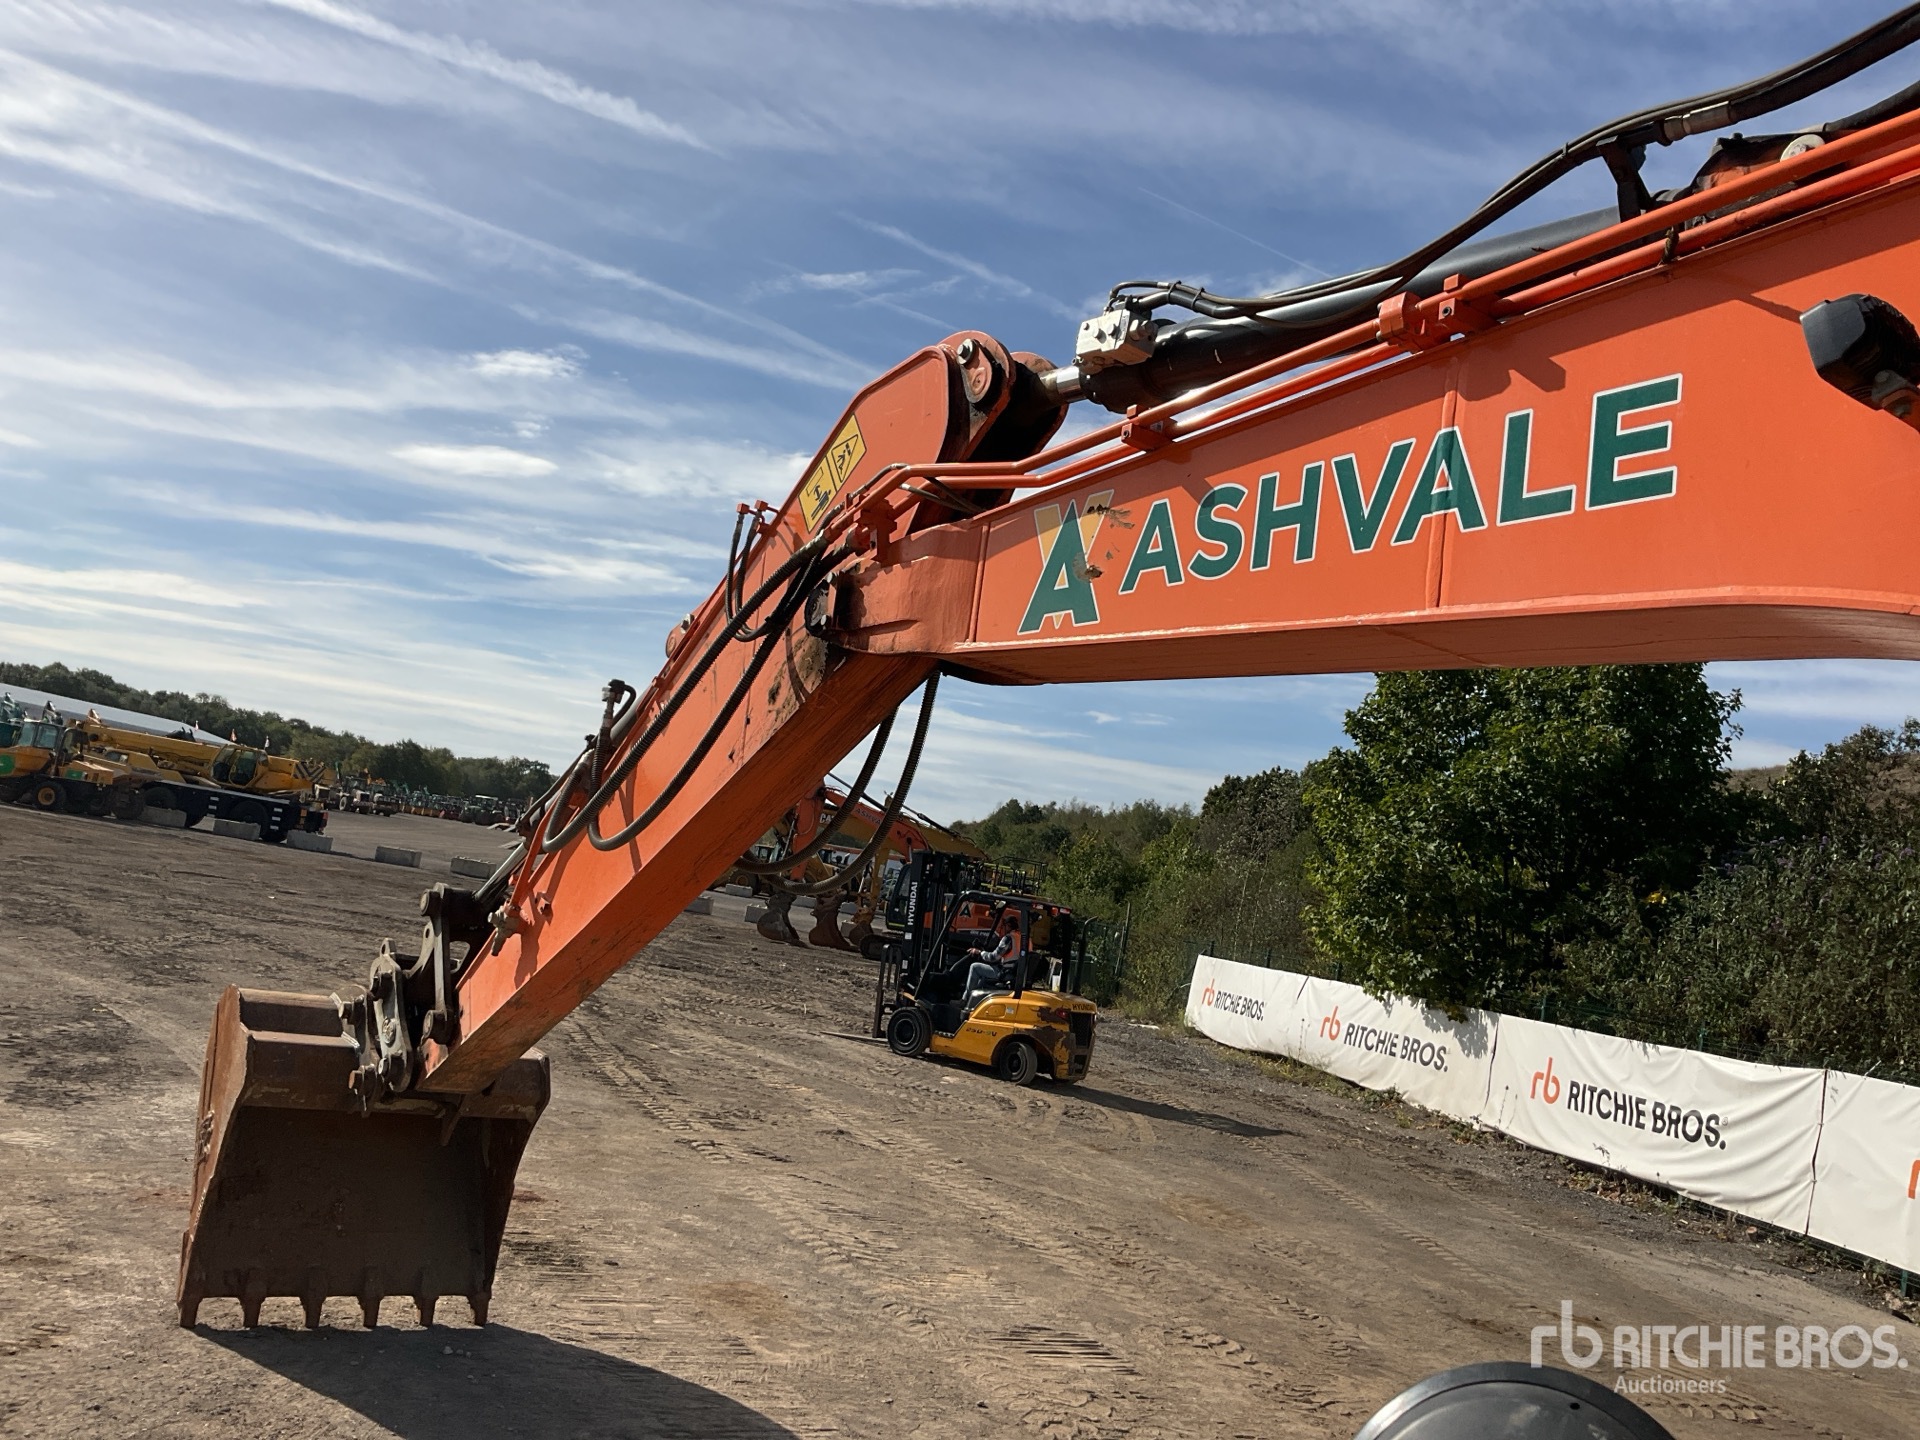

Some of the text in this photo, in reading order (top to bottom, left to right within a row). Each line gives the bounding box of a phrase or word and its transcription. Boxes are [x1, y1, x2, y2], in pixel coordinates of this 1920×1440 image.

[1118, 373, 1684, 596] ASHVALE
[856, 807, 882, 825] ASHVA
[907, 881, 918, 926] HYUNDAI
[1202, 978, 1264, 1021] rb RITCHIE BROS.
[1319, 1005, 1448, 1072] rb RITCHIE BROS.
[1530, 1057, 1727, 1151] rb RITCHIE BROS.
